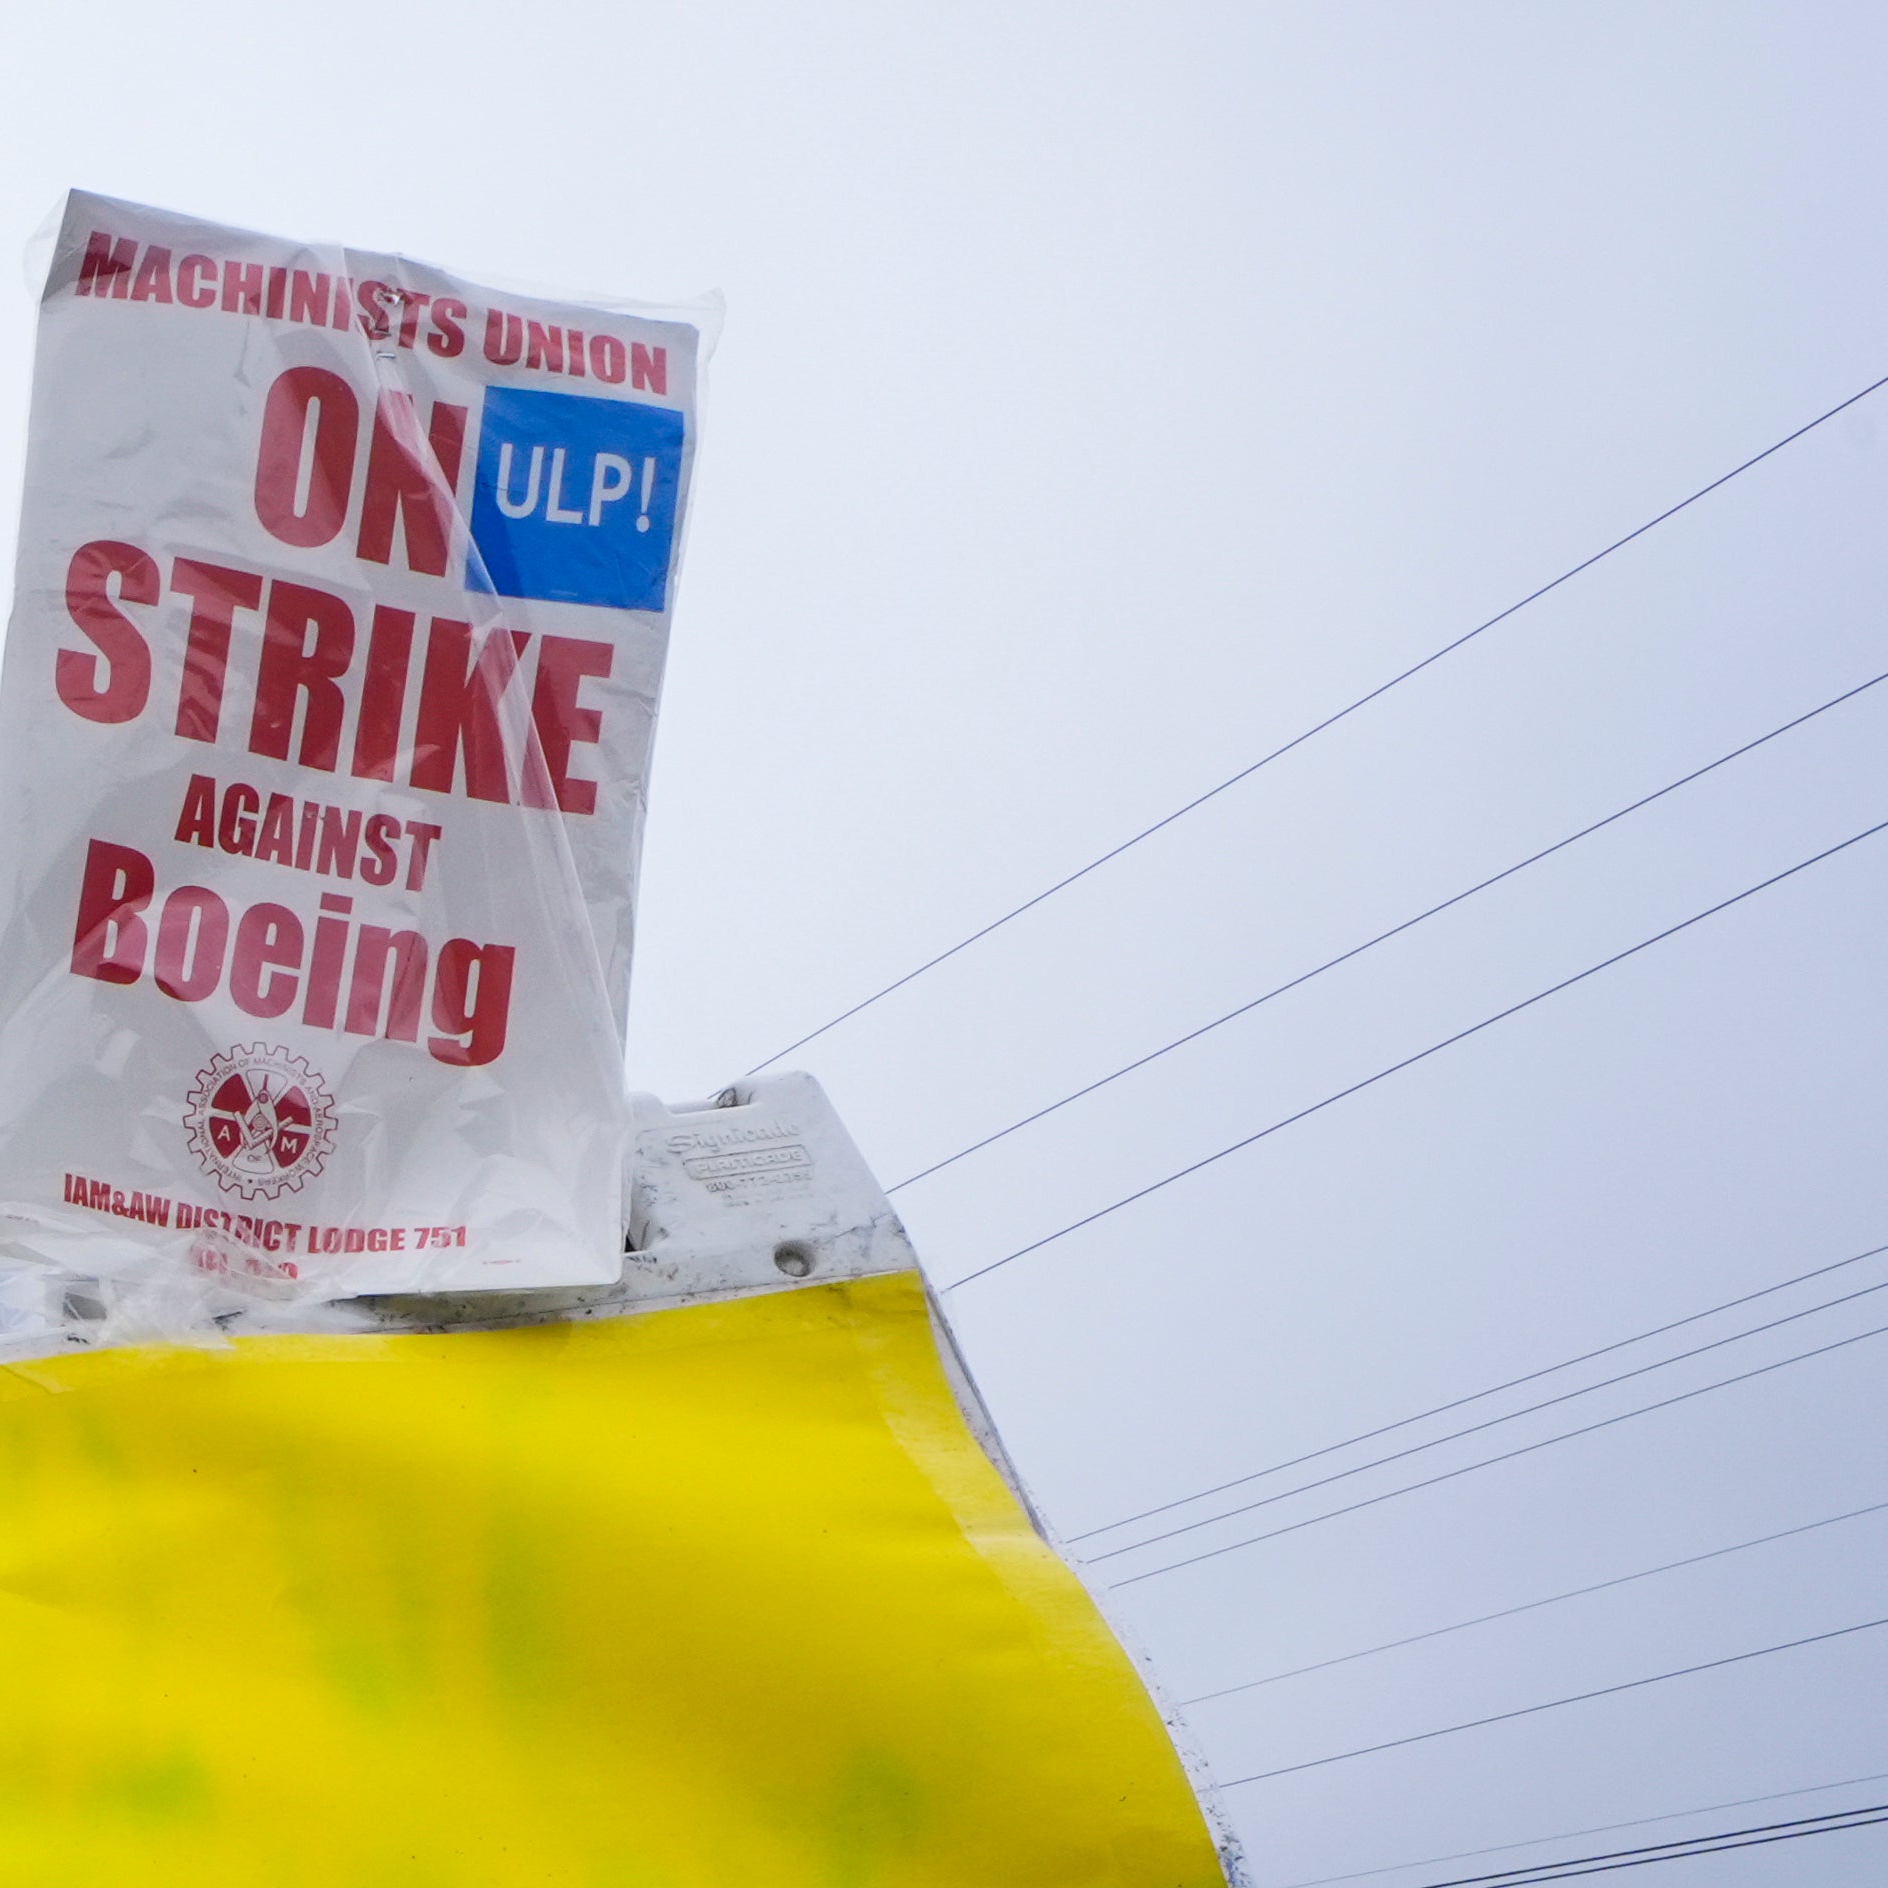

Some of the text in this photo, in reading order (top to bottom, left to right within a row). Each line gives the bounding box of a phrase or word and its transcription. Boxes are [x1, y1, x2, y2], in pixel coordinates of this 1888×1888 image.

[75, 231, 668, 396] MACHINISTS UNION
[253, 365, 469, 578] ON
[496, 442, 656, 533] ULP!
[54, 539, 615, 816] STRIKE
[175, 774, 441, 892] AGAINST
[69, 838, 517, 1068] Boeing
[64, 1173, 467, 1254] IAM&AW DISTRICT LODGE 751
